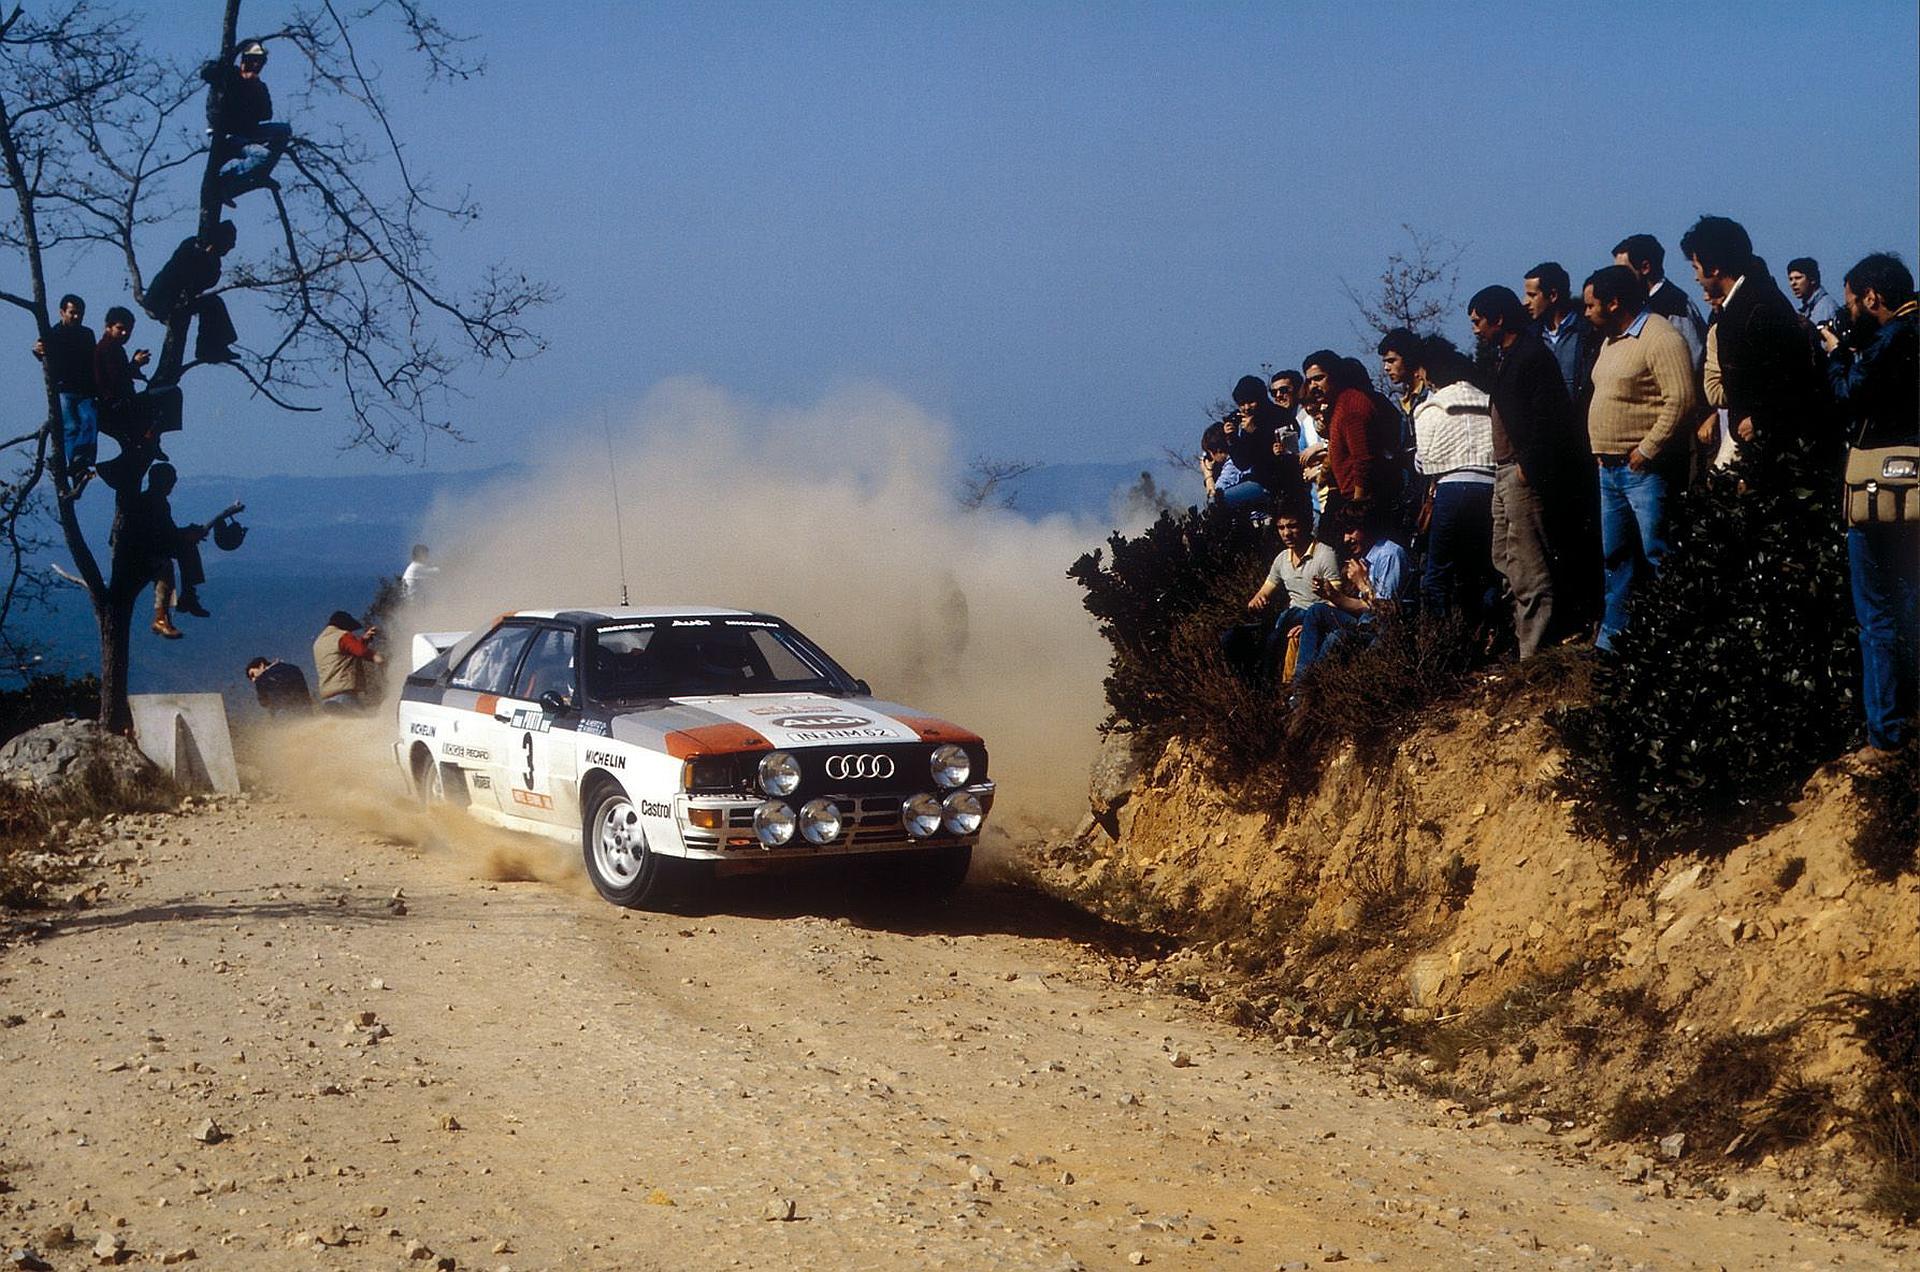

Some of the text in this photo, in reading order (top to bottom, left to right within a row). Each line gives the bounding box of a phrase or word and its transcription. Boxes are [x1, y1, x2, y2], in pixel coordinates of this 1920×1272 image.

[522, 731, 534, 791] 3
[585, 749, 626, 769] MICHELIN
[641, 799, 672, 819] Castrol
